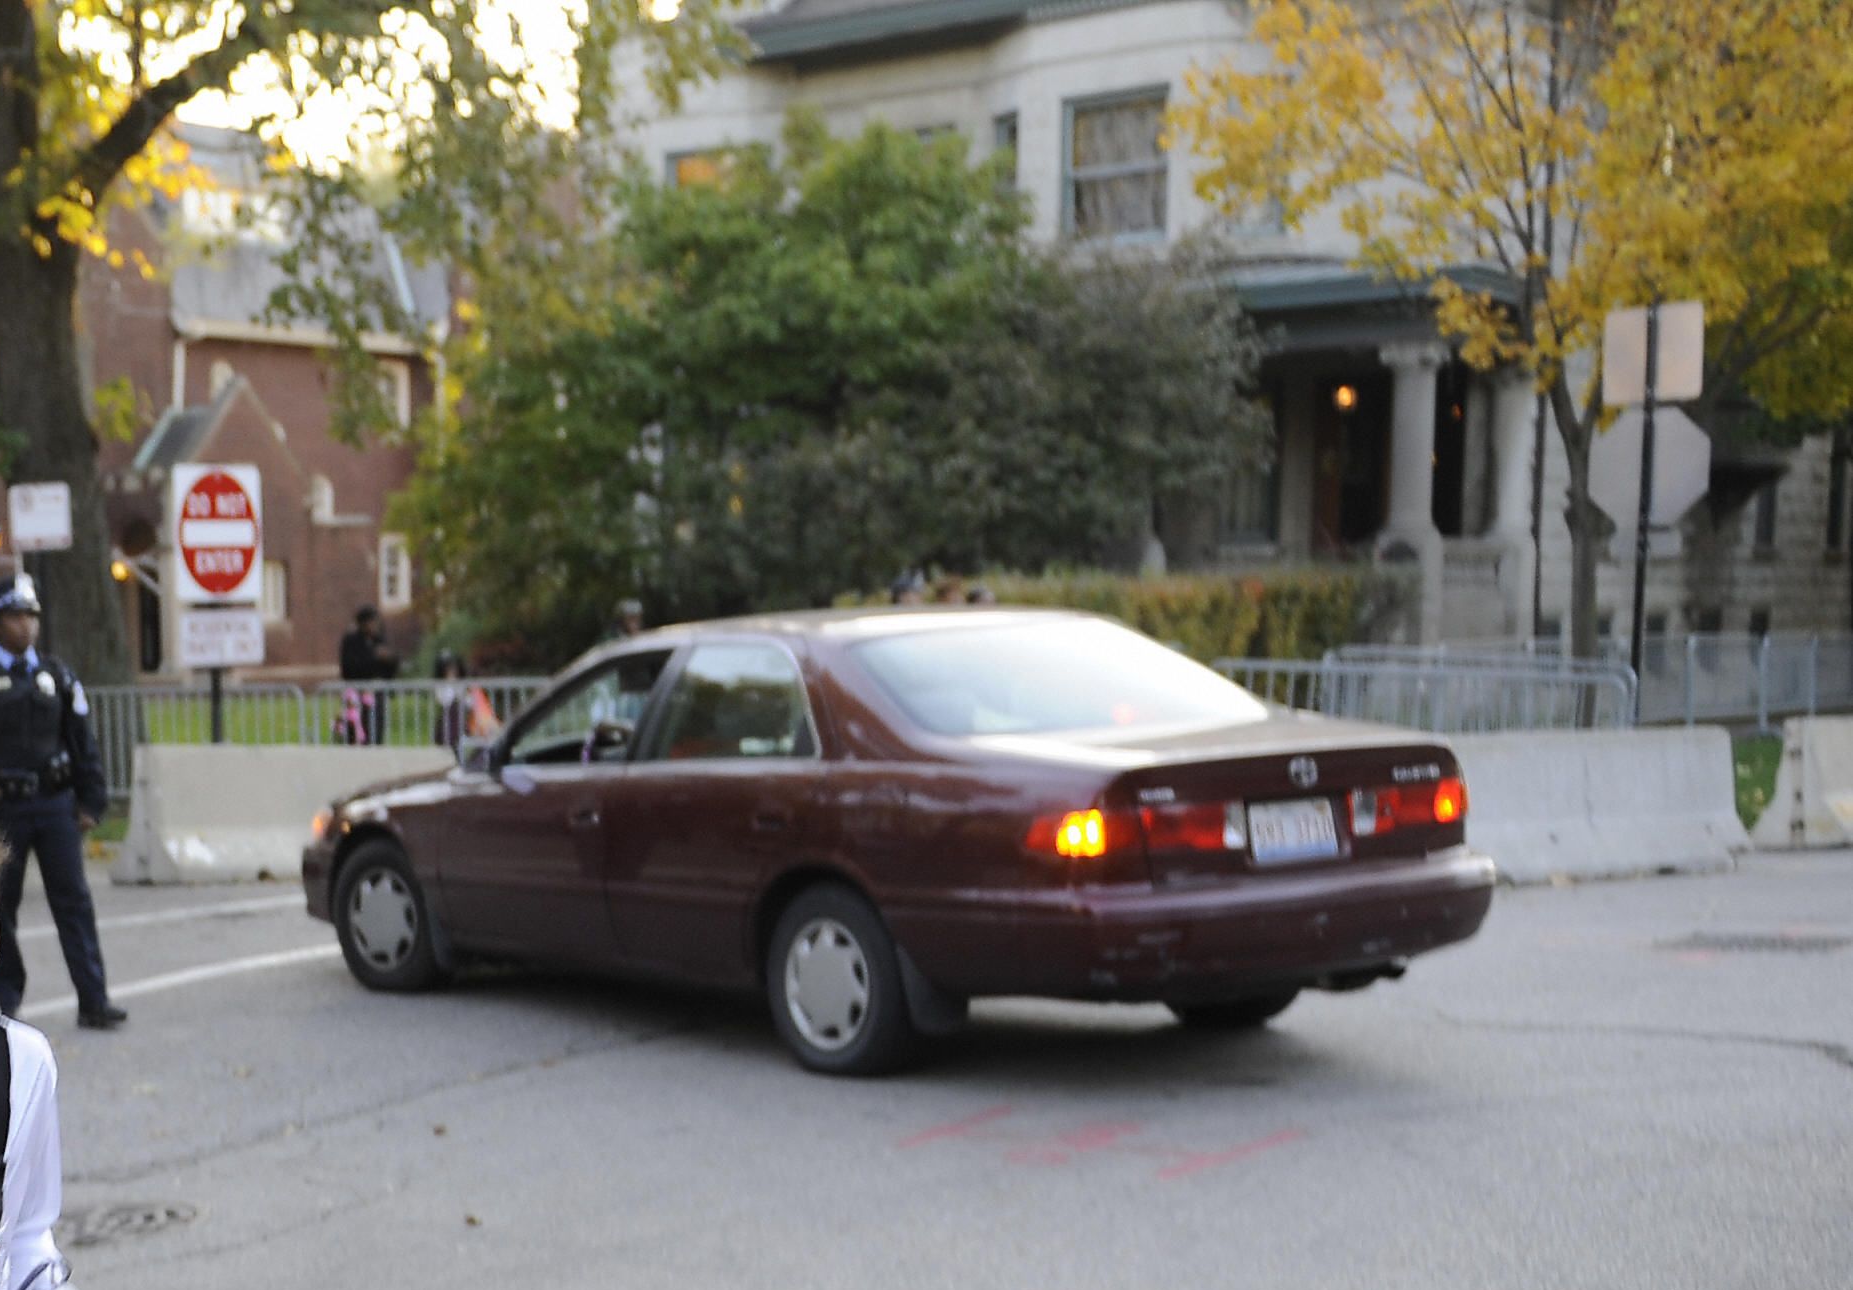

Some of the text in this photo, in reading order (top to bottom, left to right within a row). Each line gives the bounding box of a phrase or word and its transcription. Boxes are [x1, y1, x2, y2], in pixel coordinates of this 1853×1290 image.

[188, 492, 246, 516] DO NOT
[195, 550, 244, 575] ENTER
